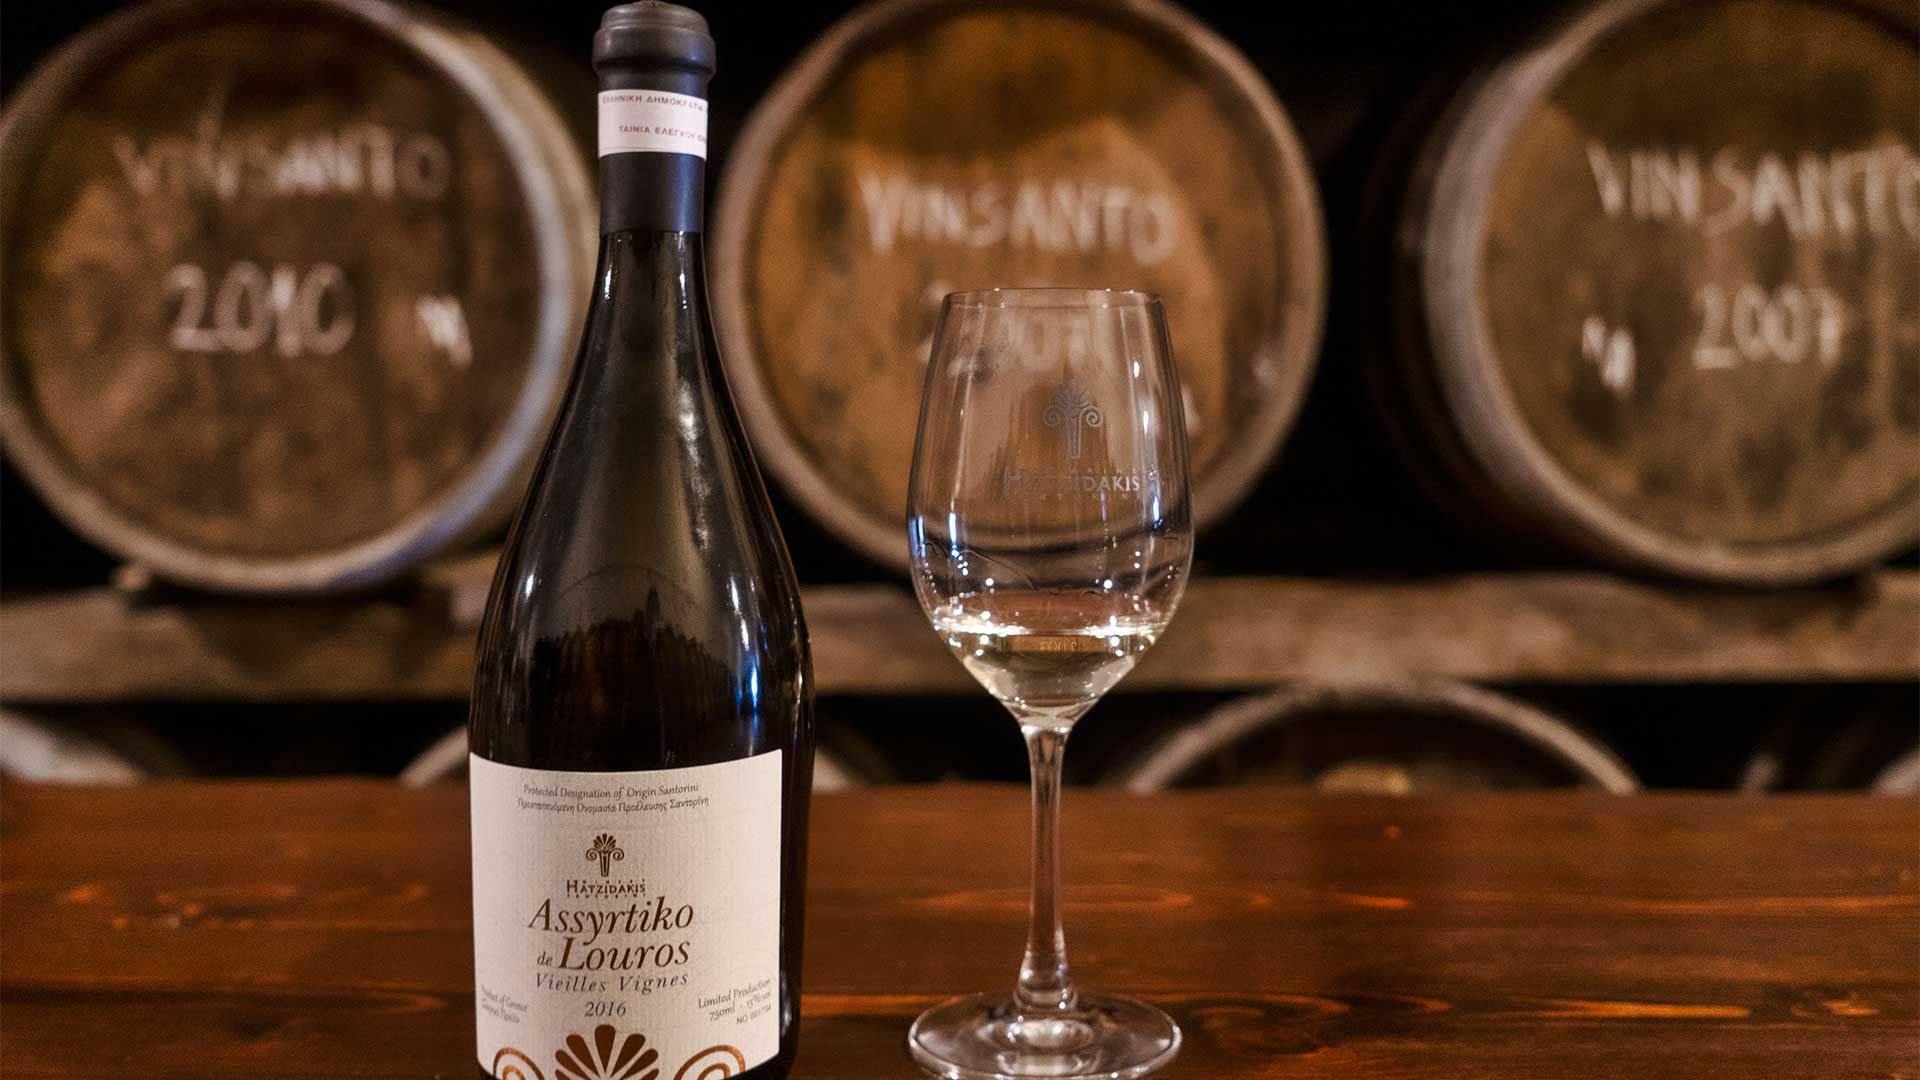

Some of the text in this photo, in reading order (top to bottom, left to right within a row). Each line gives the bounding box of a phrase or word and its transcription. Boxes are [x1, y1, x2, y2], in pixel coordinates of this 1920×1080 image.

[619, 126, 650, 134] ΤΑΙΝΙΑ
[858, 175, 1177, 262] VINSANTO
[163, 262, 356, 357] 2010
[1691, 282, 1845, 373] 2007
[523, 783, 699, 801] Protected Designation of Origin Santorini
[566, 879, 646, 894] HATZIDAKIS
[528, 896, 695, 946] Assyrtiko
[536, 936, 691, 971] de Louros
[535, 972, 689, 994] Vieilles Vignes
[698, 979, 771, 1009] Limited Production
[583, 1001, 627, 1018] 2016
[709, 1000, 736, 1021] 750ml
